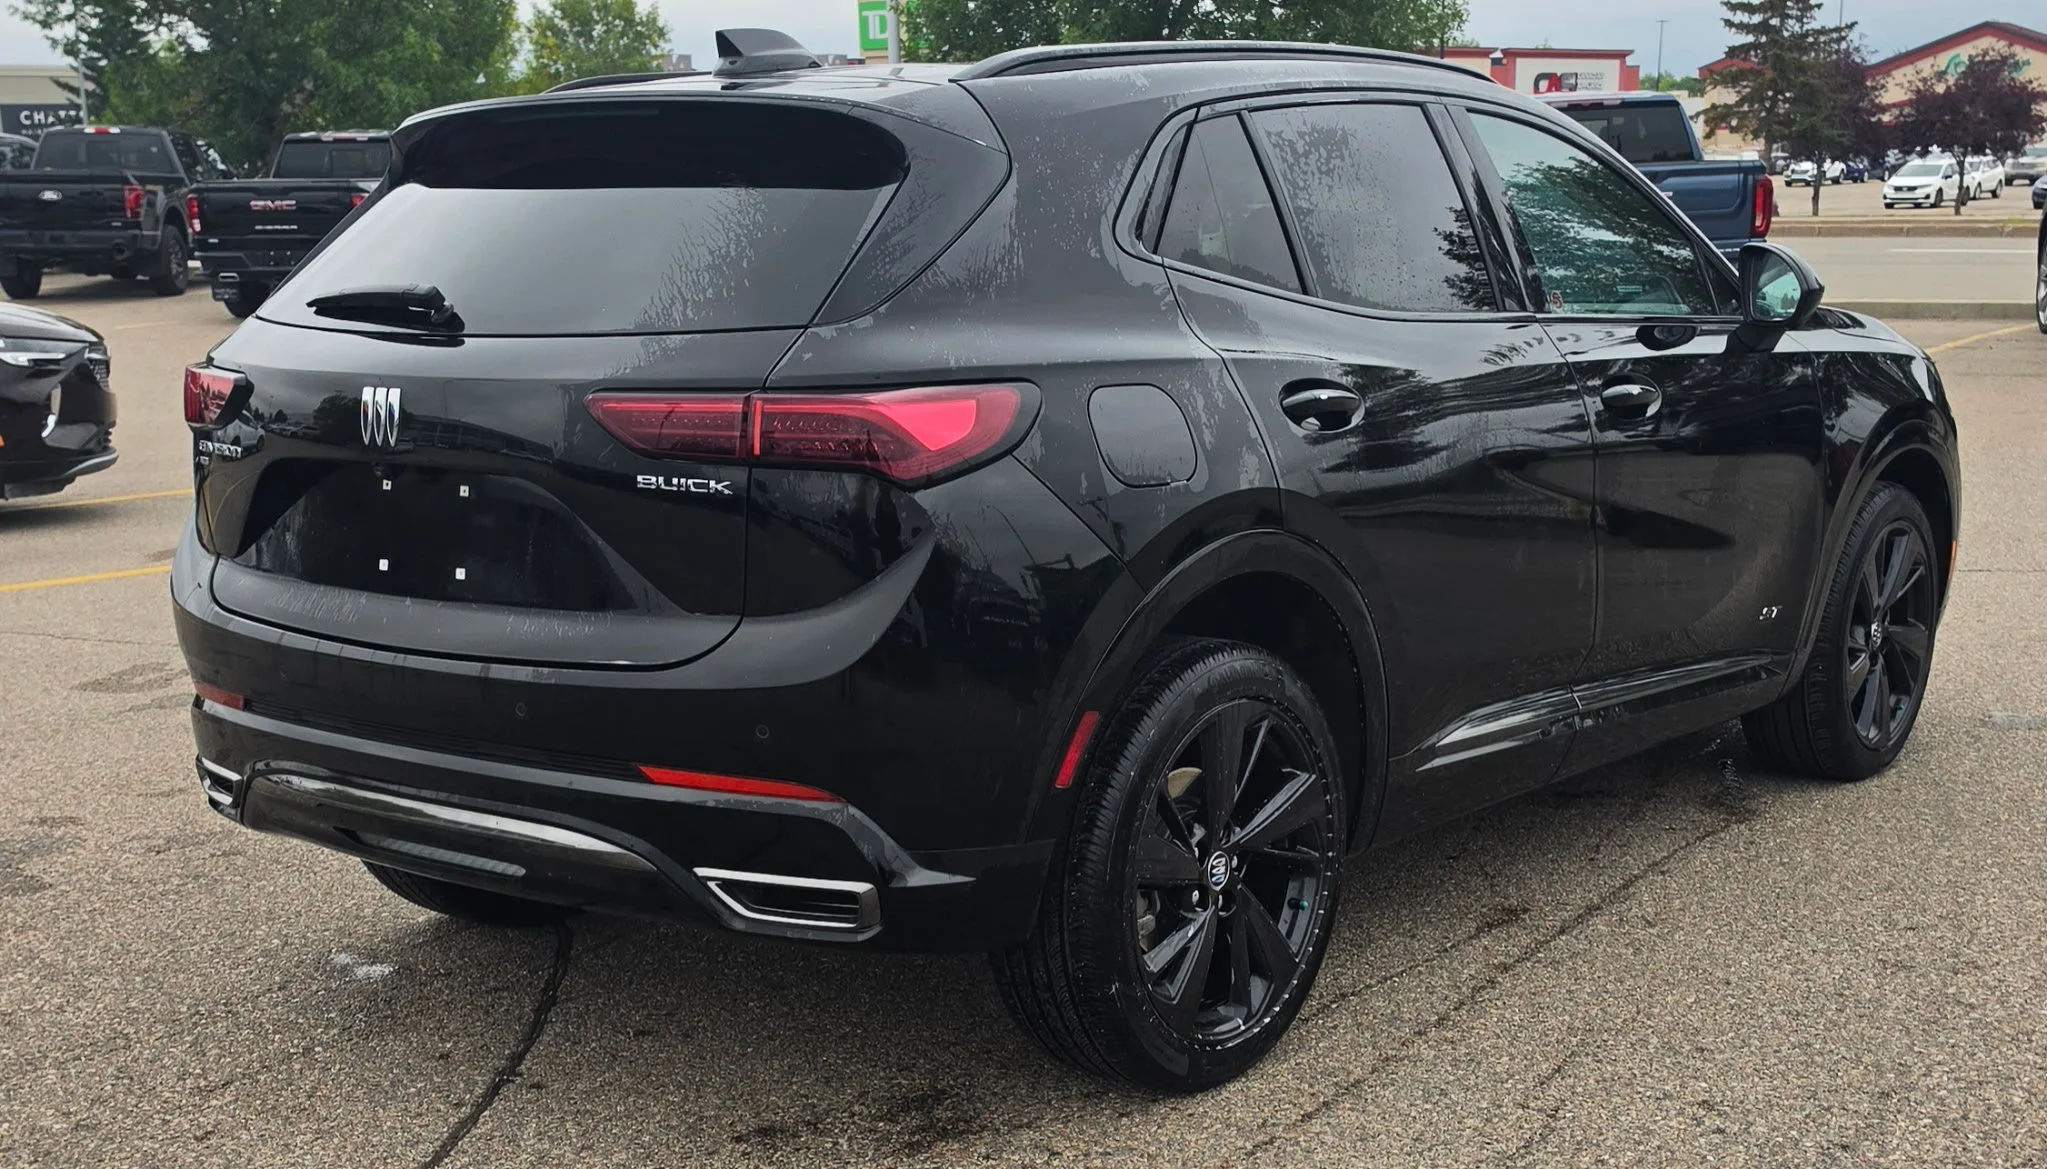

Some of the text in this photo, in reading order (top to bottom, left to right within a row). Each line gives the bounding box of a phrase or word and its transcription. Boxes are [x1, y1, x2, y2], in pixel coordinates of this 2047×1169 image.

[862, 10, 889, 40] TD
[249, 200, 297, 211] GMC
[636, 475, 734, 495] BUICK
